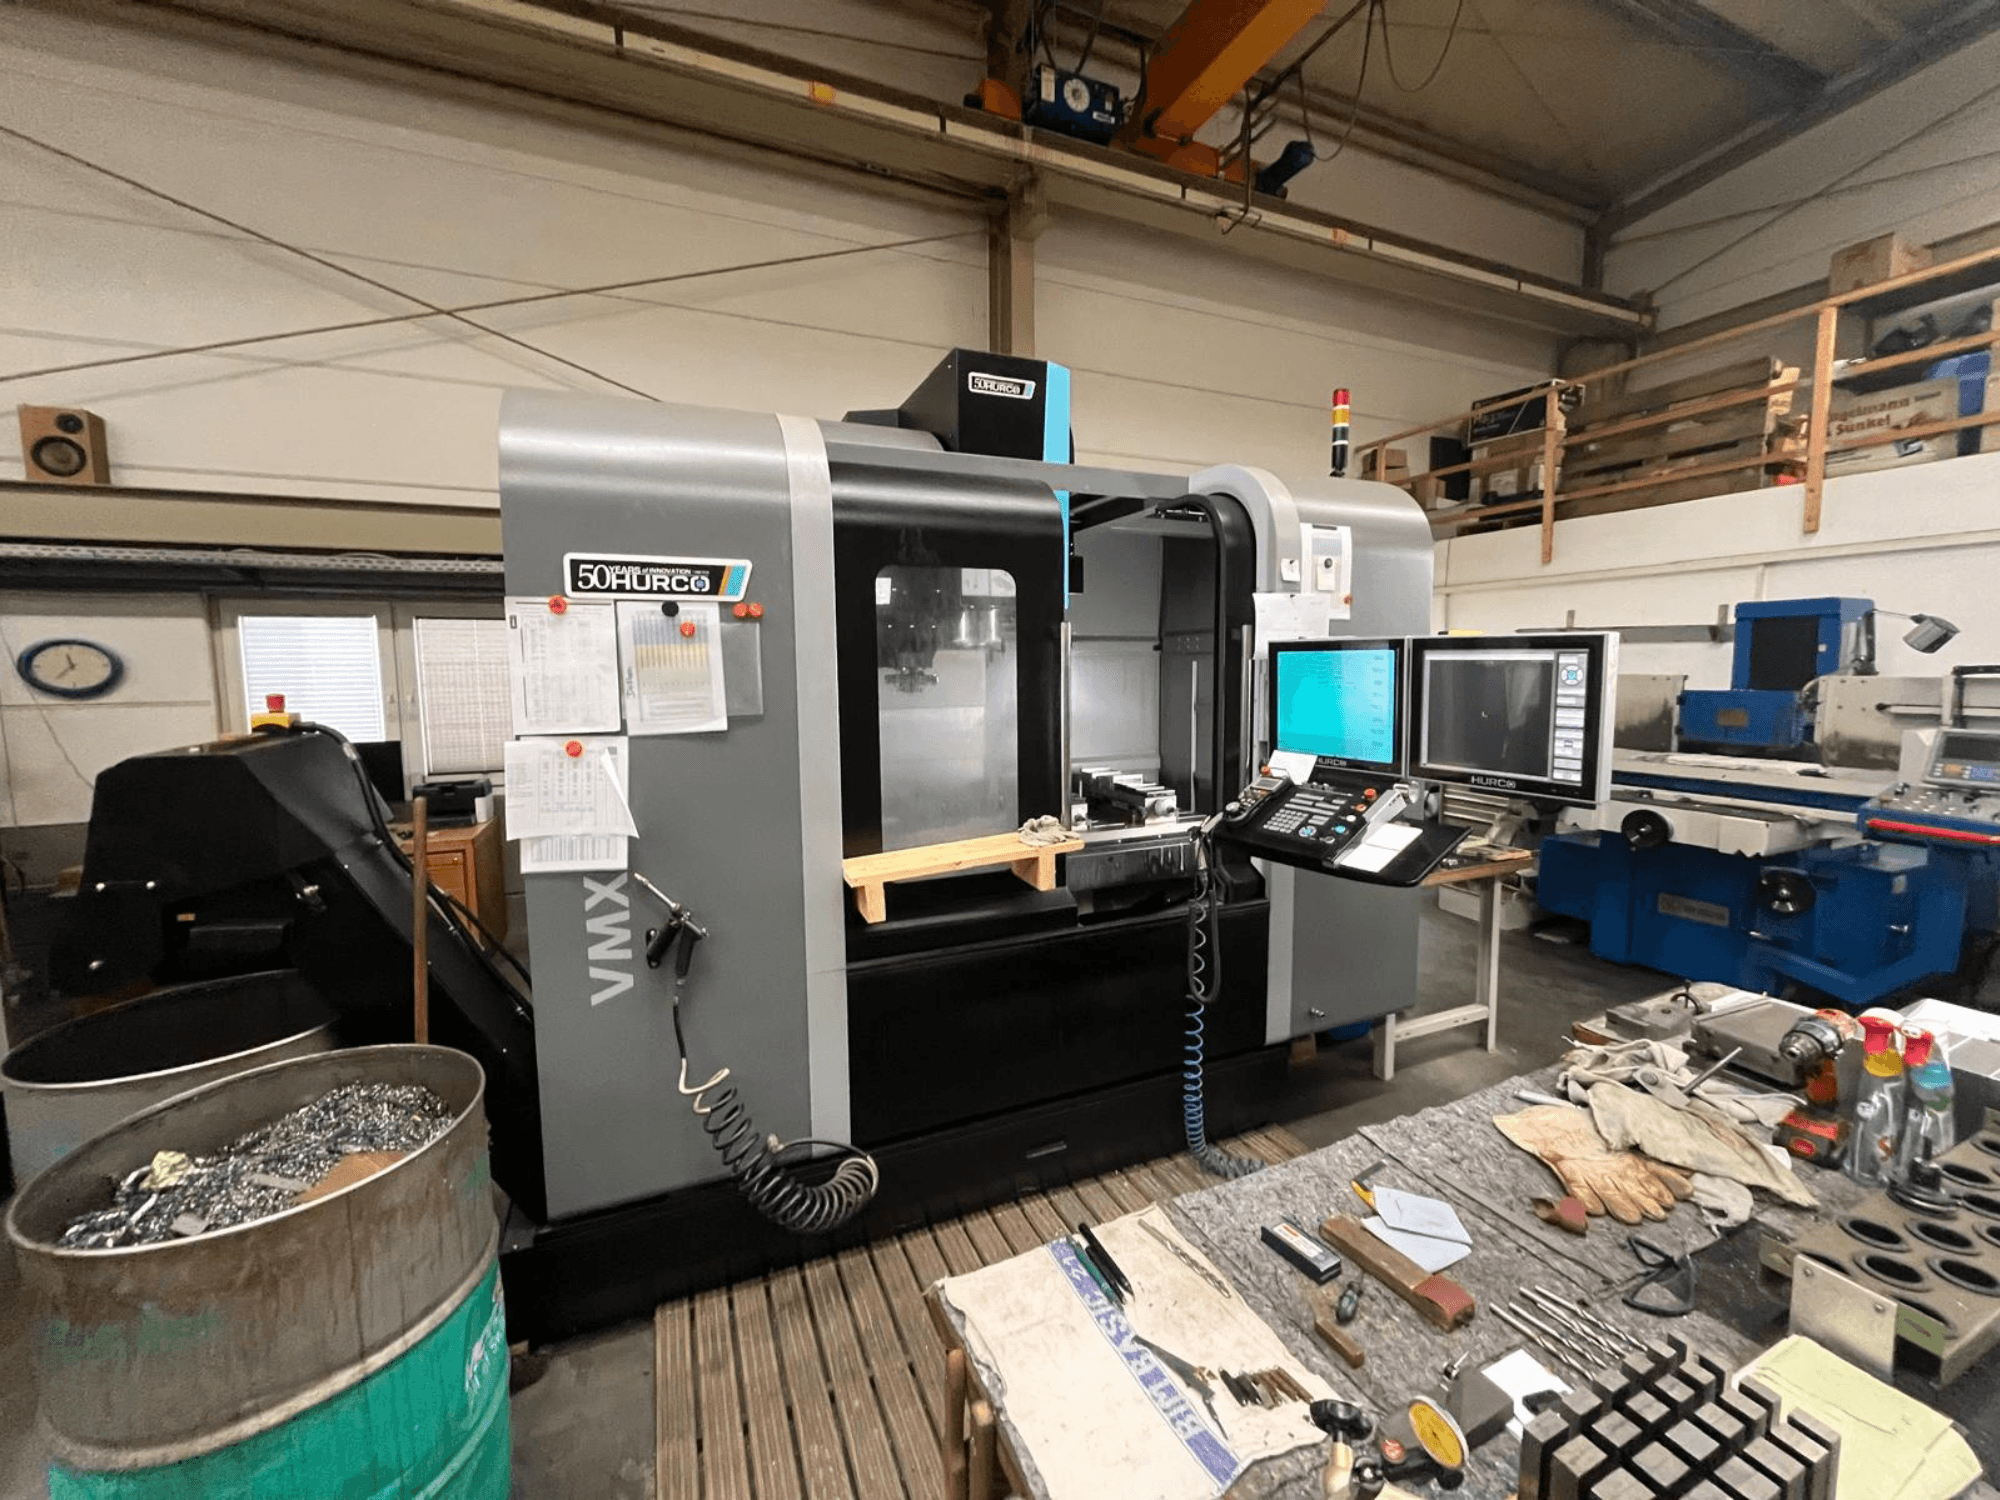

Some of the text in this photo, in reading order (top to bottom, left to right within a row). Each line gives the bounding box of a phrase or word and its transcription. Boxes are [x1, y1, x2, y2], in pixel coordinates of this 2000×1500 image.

[986, 380, 1021, 394] HURCO
[577, 563, 611, 590] 50
[609, 565, 642, 575] YEARS
[649, 566, 691, 575] INNOVATION
[611, 573, 710, 592] HURCO
[1471, 774, 1516, 789] HURCO
[583, 872, 634, 1006] VMX
